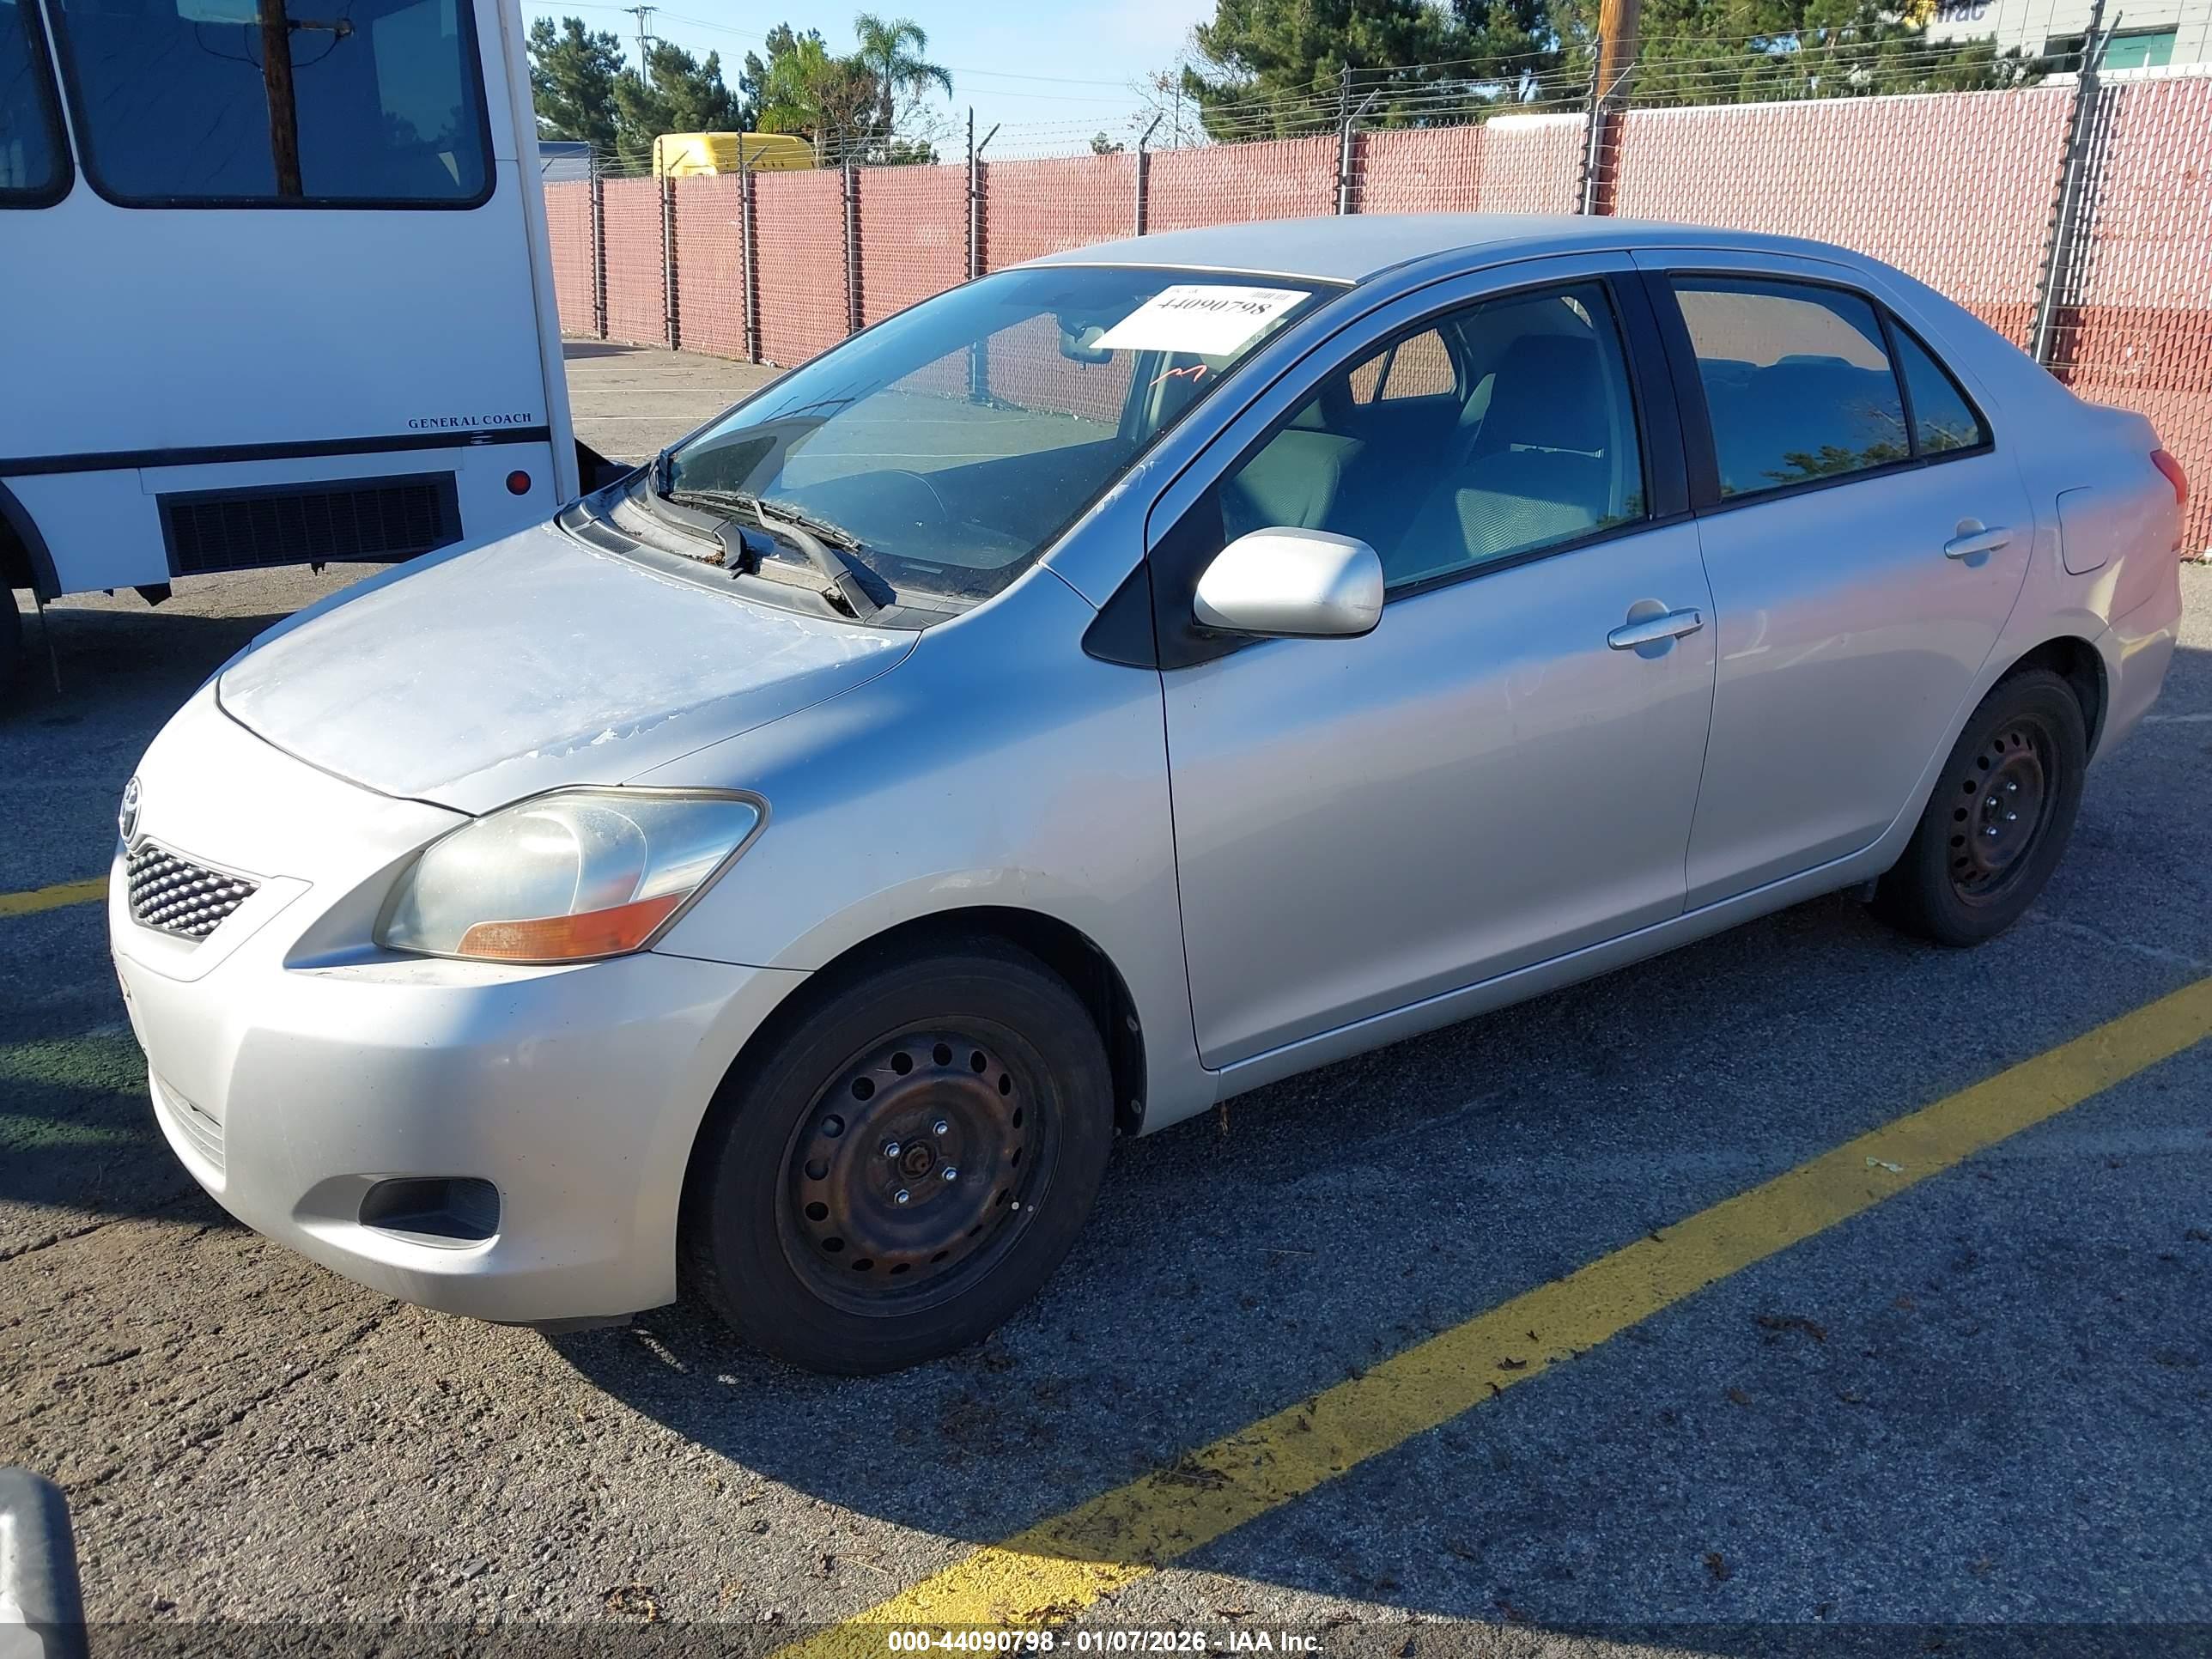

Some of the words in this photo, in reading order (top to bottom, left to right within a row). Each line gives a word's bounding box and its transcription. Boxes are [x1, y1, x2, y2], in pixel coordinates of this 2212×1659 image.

[1158, 298, 1273, 315] 44090798
[408, 416, 479, 428] GENERAL
[483, 412, 532, 425] COACH
